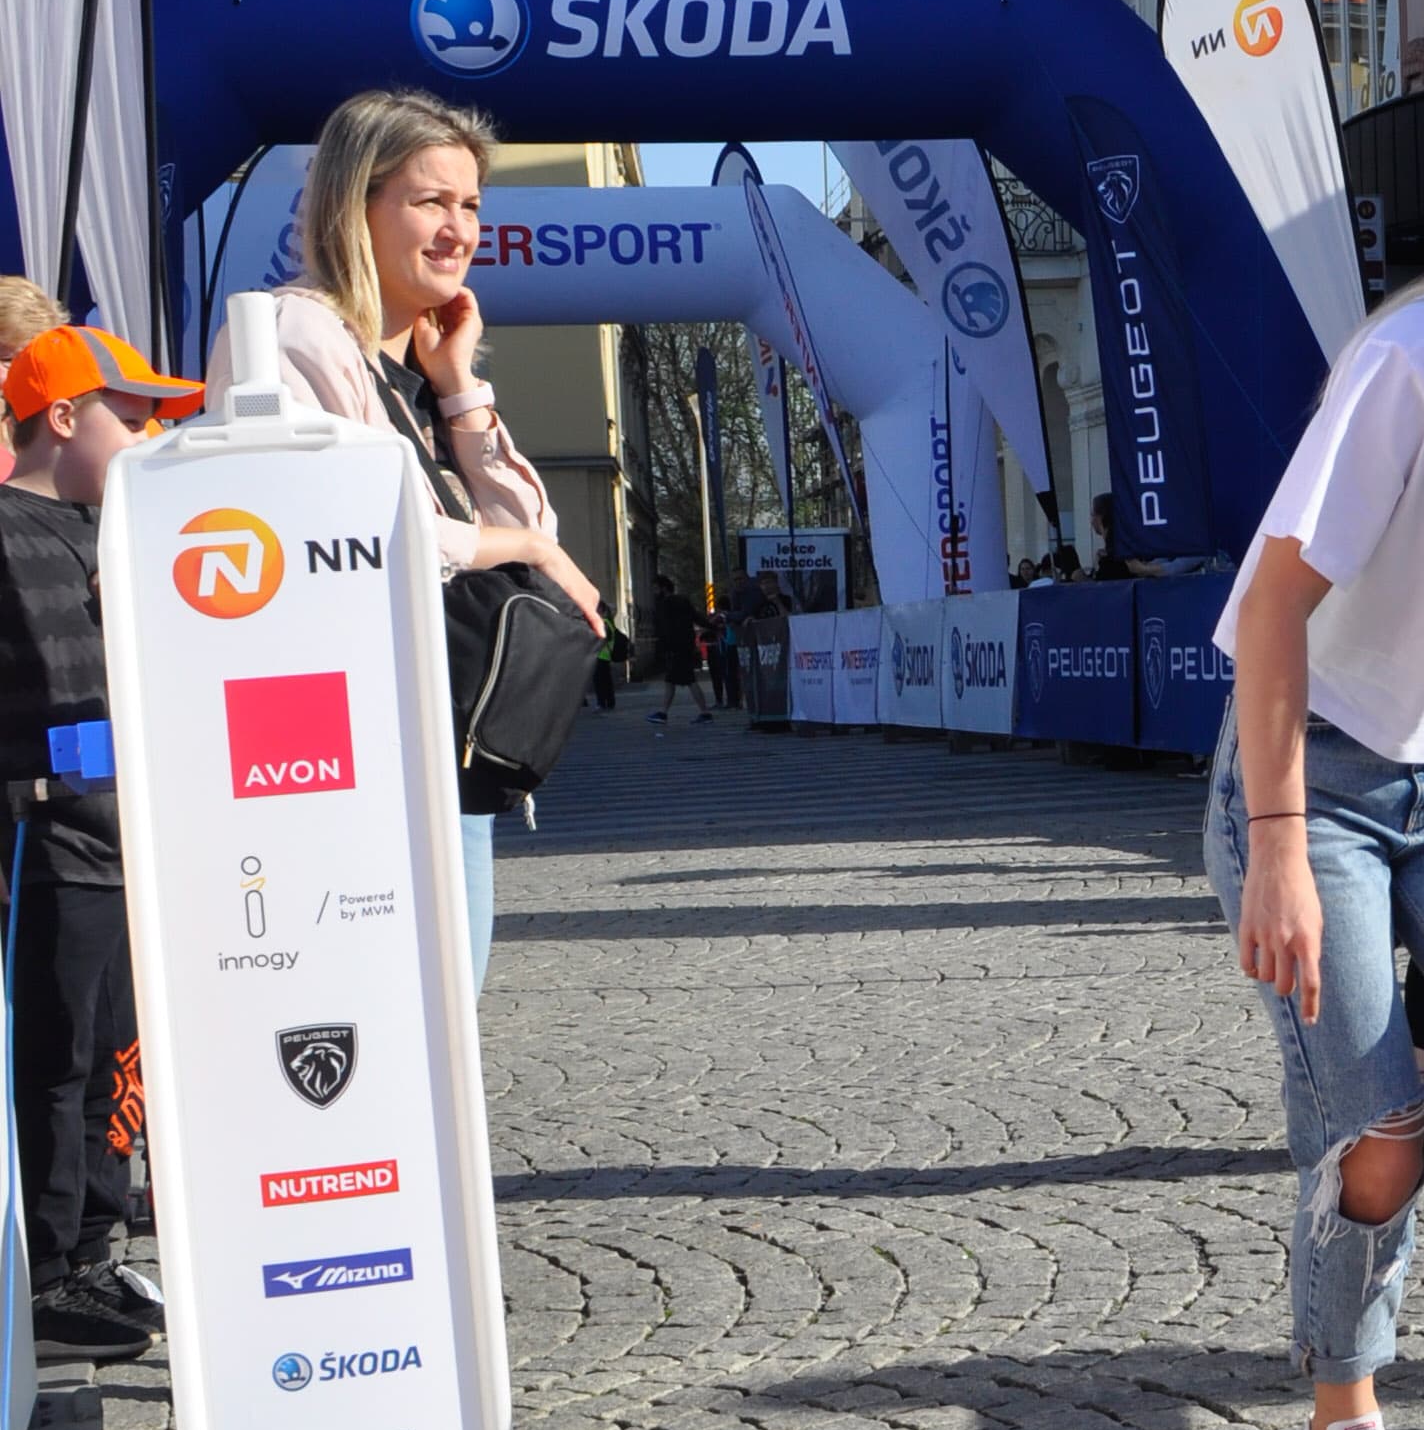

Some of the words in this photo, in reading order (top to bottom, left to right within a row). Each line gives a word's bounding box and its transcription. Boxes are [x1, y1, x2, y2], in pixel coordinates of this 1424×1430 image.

[473, 222, 709, 267] ERSPORT
[1111, 239, 1168, 527] PEUGEOT
[304, 536, 383, 574] NN
[905, 638, 935, 687] ŠKODA
[966, 633, 1008, 688] ŠKODA
[1048, 646, 1131, 678] PEUGEOT
[1170, 646, 1235, 681] PEUG
[244, 757, 341, 788] AVON
[338, 890, 395, 905] Powered
[340, 908, 356, 921] by
[361, 904, 395, 918] MVM
[217, 947, 300, 973] innogy
[282, 1028, 350, 1045] PEUGEOT
[267, 1168, 393, 1201] NUTREND
[319, 1345, 422, 1384] ŠKODA
